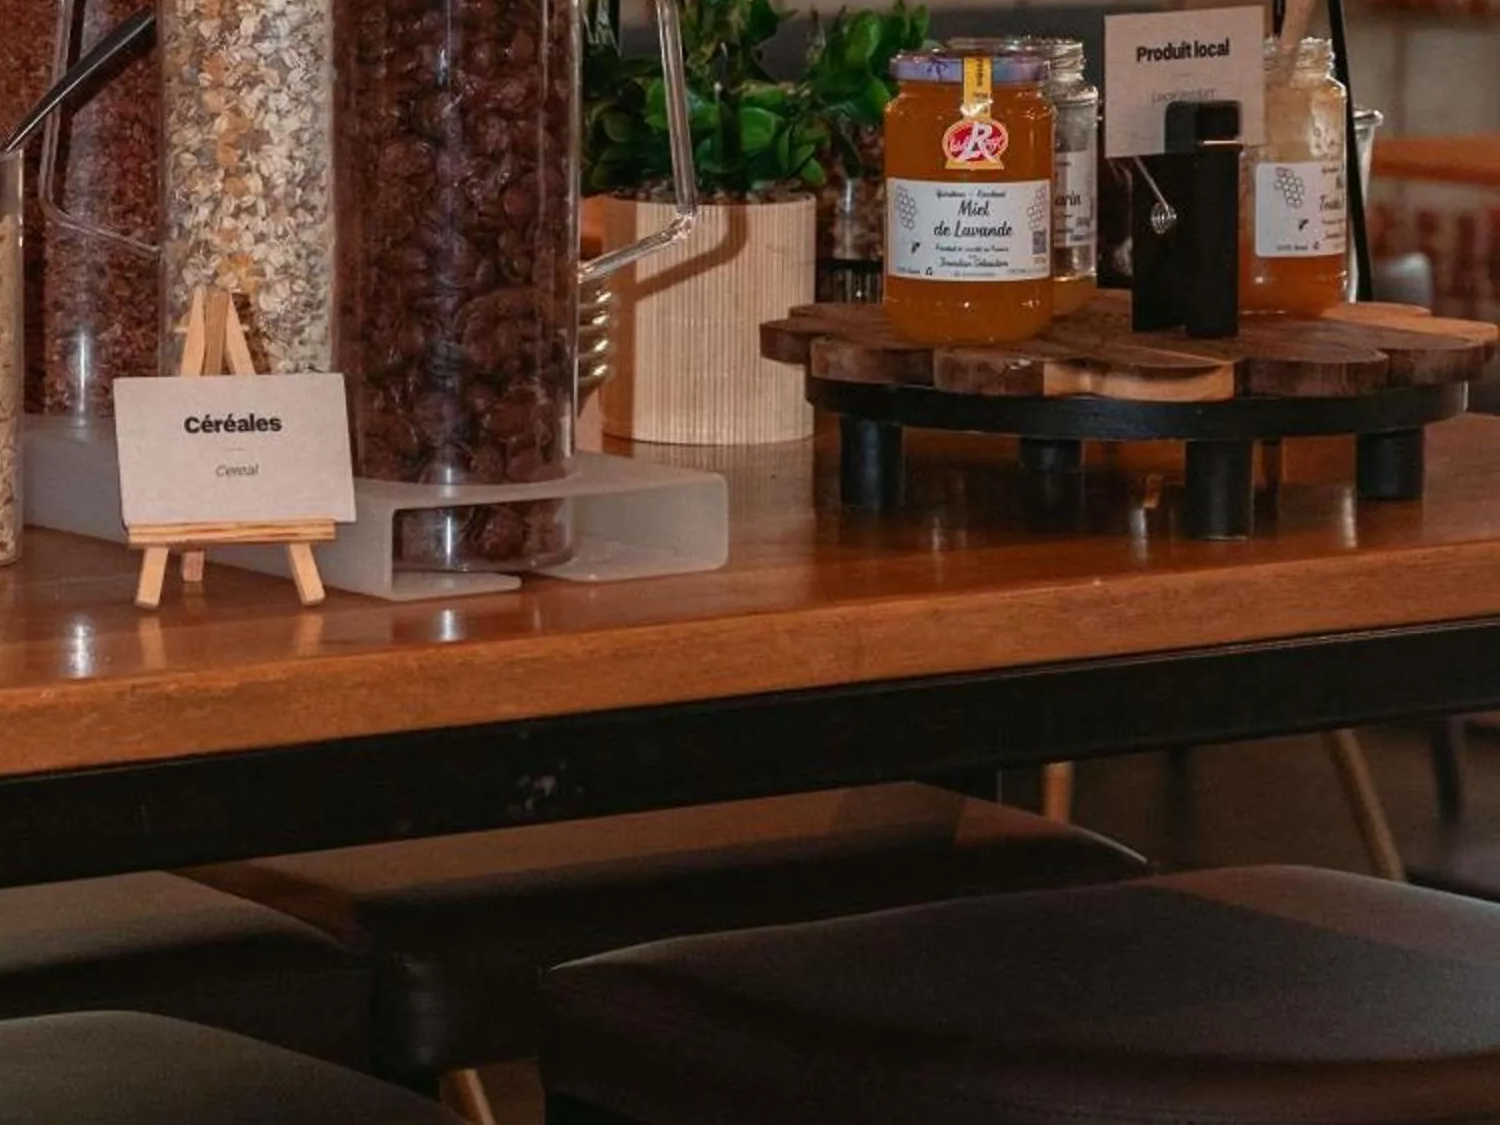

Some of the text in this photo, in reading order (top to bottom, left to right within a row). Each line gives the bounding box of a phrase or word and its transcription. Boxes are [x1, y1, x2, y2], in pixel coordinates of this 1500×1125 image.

[1136, 38, 1231, 63] Produit local
[957, 199, 990, 217] Miel
[933, 220, 1014, 238] de Lavande
[184, 413, 283, 434] Céréales
[215, 463, 260, 478] Cereal
